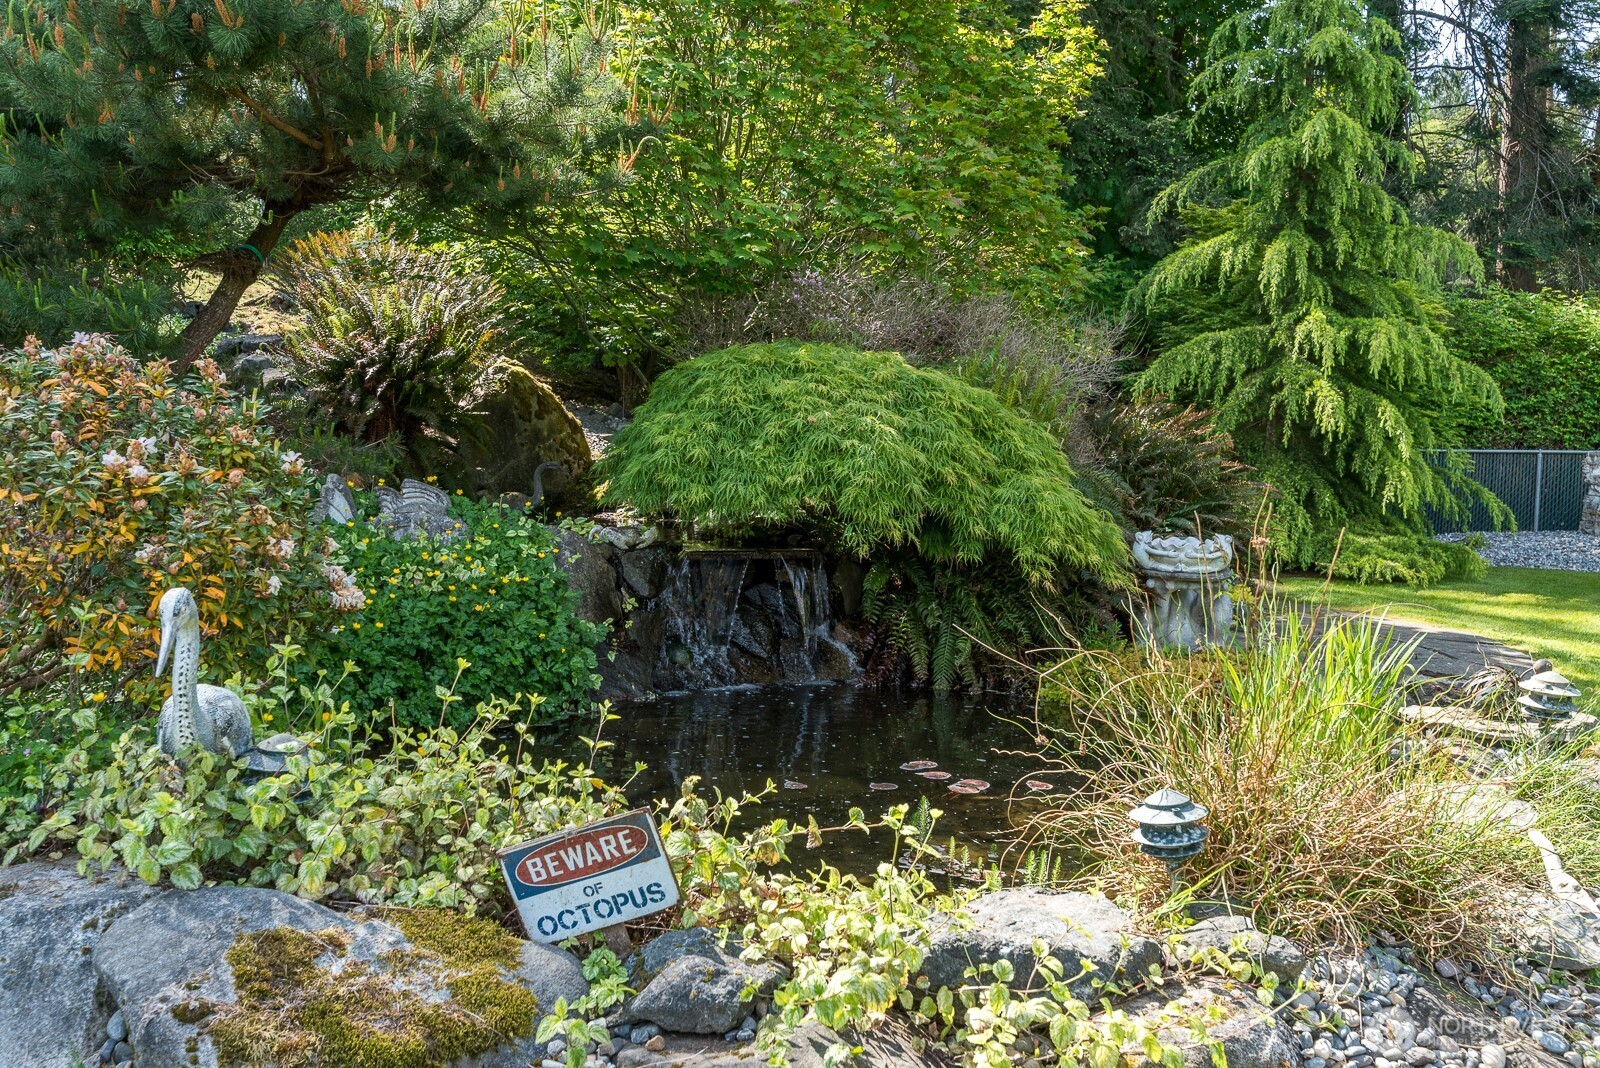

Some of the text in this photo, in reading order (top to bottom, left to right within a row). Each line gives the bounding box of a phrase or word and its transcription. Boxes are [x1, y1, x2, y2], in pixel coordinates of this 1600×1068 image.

[526, 829, 637, 883] BEWARE
[537, 882, 666, 936] OCTOPUS
[583, 882, 604, 897] OF
